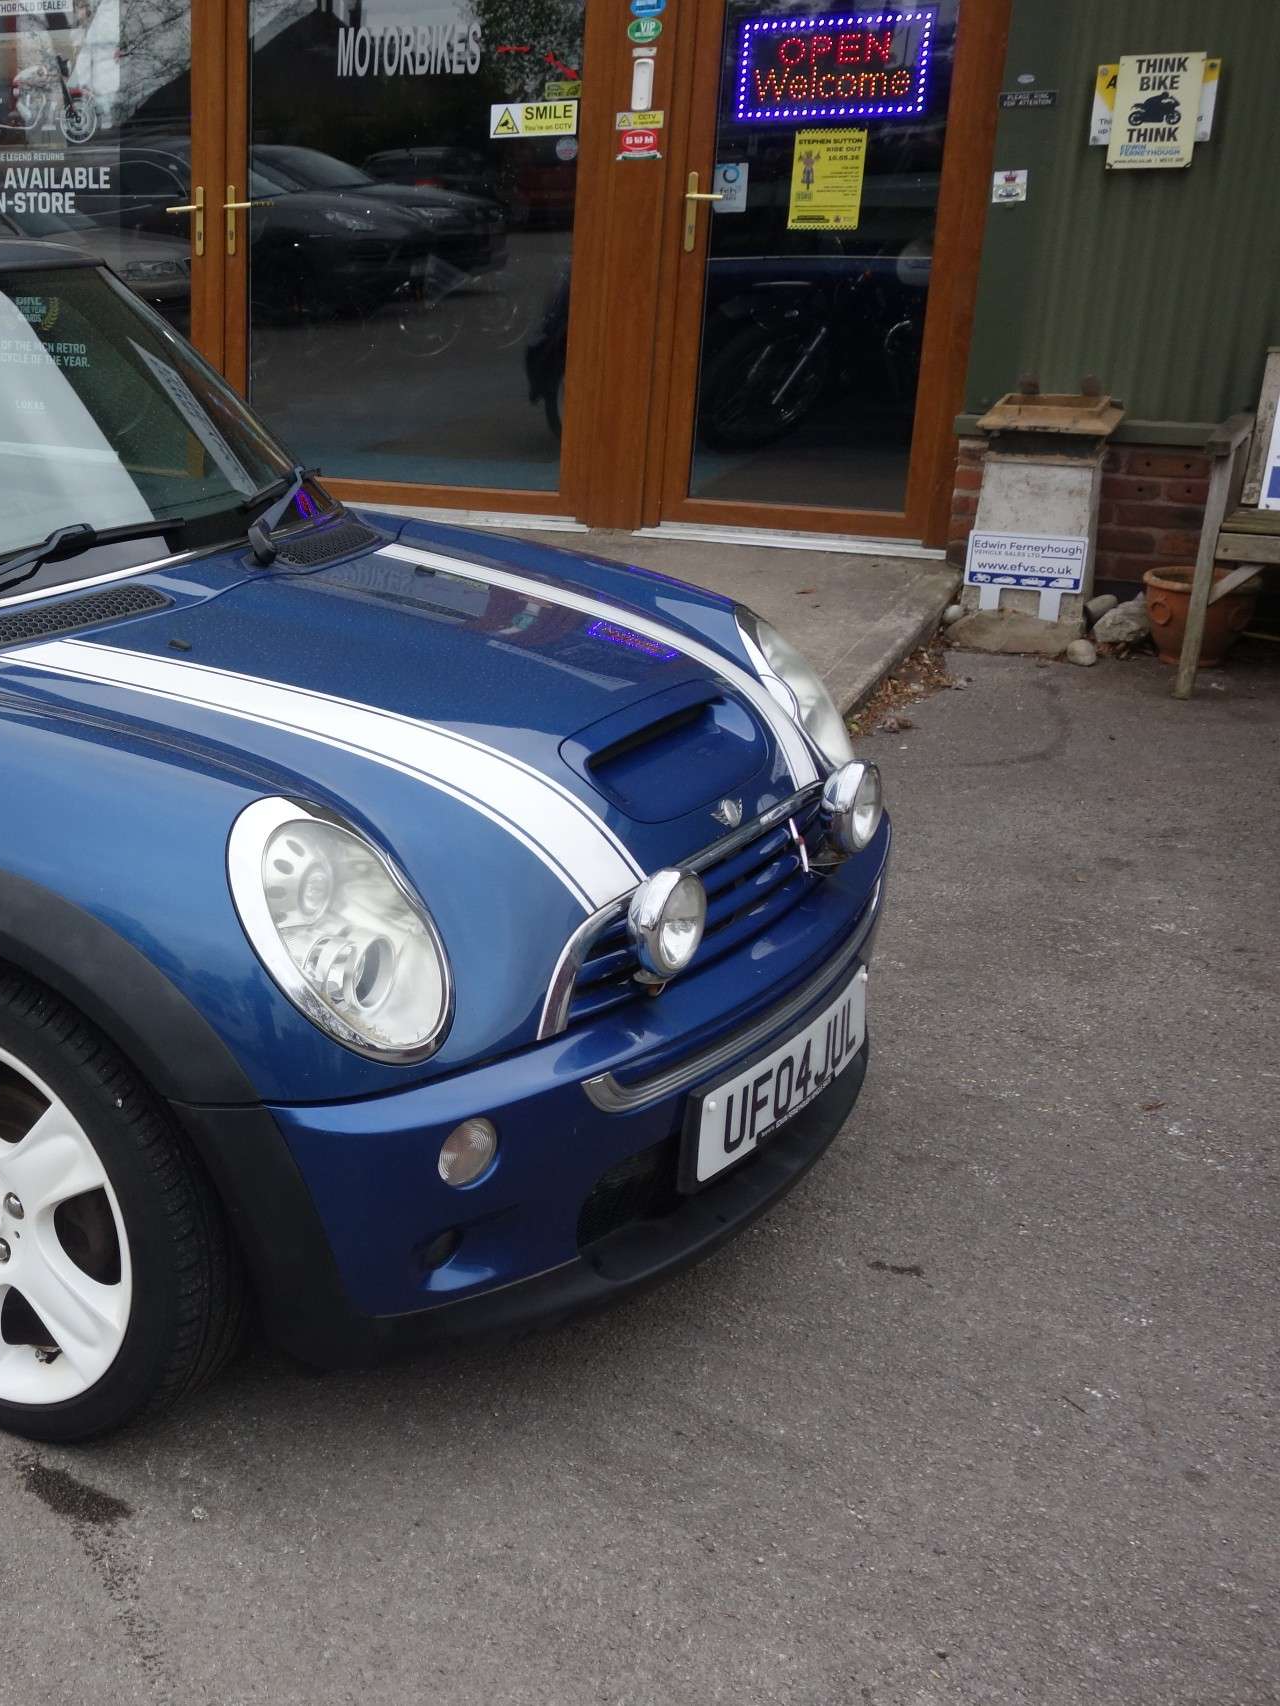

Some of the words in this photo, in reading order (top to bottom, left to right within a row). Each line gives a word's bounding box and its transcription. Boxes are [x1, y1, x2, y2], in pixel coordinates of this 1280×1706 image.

[39, 1, 68, 11] DEALER
[640, 21, 656, 32] VIP
[336, 22, 482, 77] MOTORBIKES
[779, 31, 892, 64] OPEN
[1136, 57, 1189, 74] THINK
[753, 66, 911, 102] Welcome
[1138, 75, 1181, 92] BIKE
[524, 104, 573, 121] SMILE
[638, 113, 657, 121] CCTV
[554, 122, 572, 131] CCTV
[1127, 127, 1179, 143] THINK
[6, 153, 32, 161] LEGEND
[33, 152, 64, 161] RETURNS
[4, 167, 111, 189] AVAILABLE
[56, 342, 86, 354] RETRO
[64, 356, 90, 368] YEAR.
[974, 540, 1006, 550] Edwin
[1010, 542, 1082, 556] Ferneyhough
[977, 560, 1072, 575] www.efvs.co.uk
